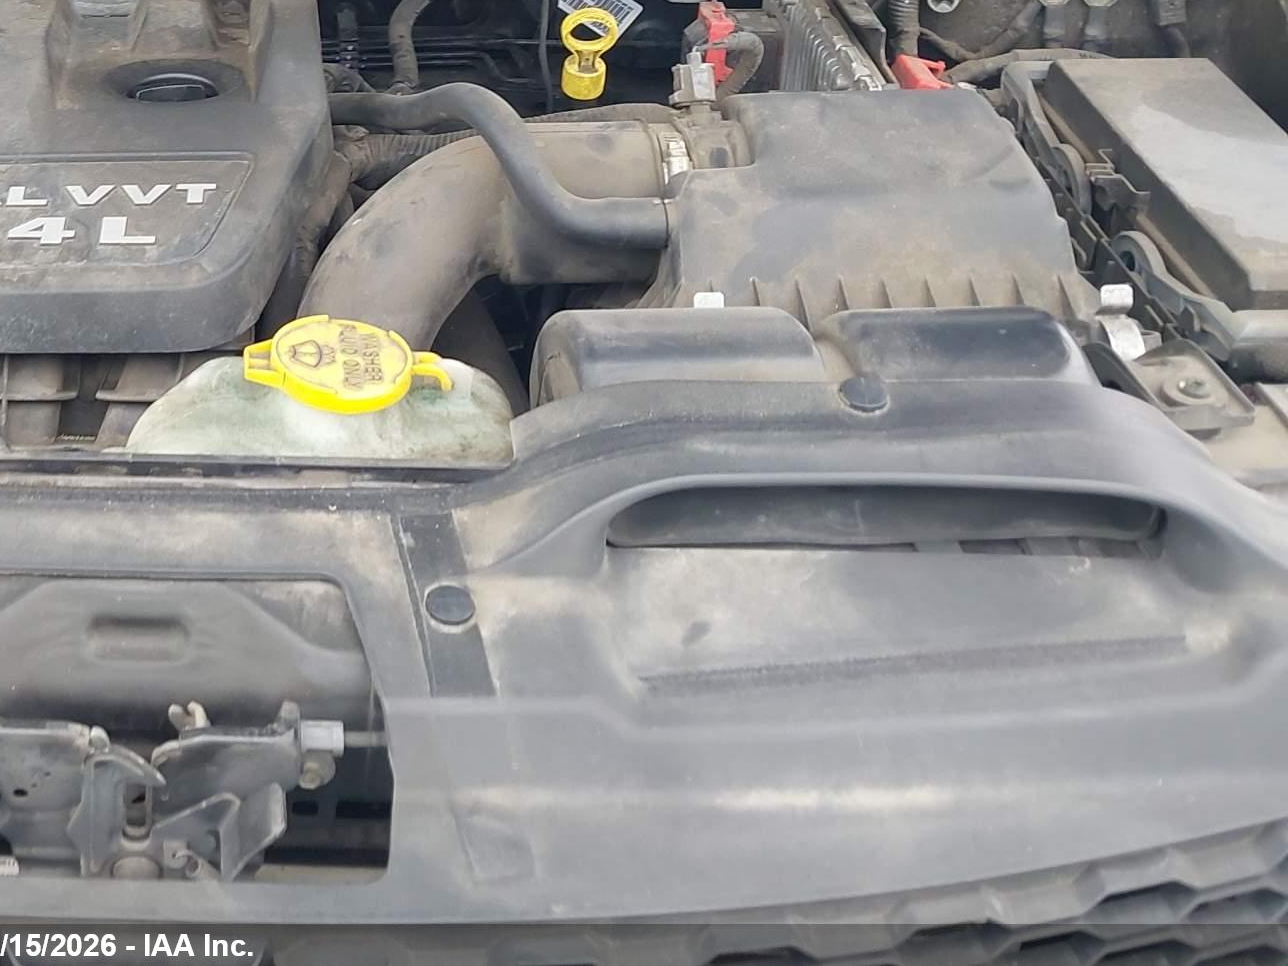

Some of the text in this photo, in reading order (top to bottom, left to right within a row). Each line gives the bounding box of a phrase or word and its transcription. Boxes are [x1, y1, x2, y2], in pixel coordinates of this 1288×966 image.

[65, 183, 217, 206] VVT
[361, 333, 384, 384] WASHER
[343, 359, 362, 391] ONLY
